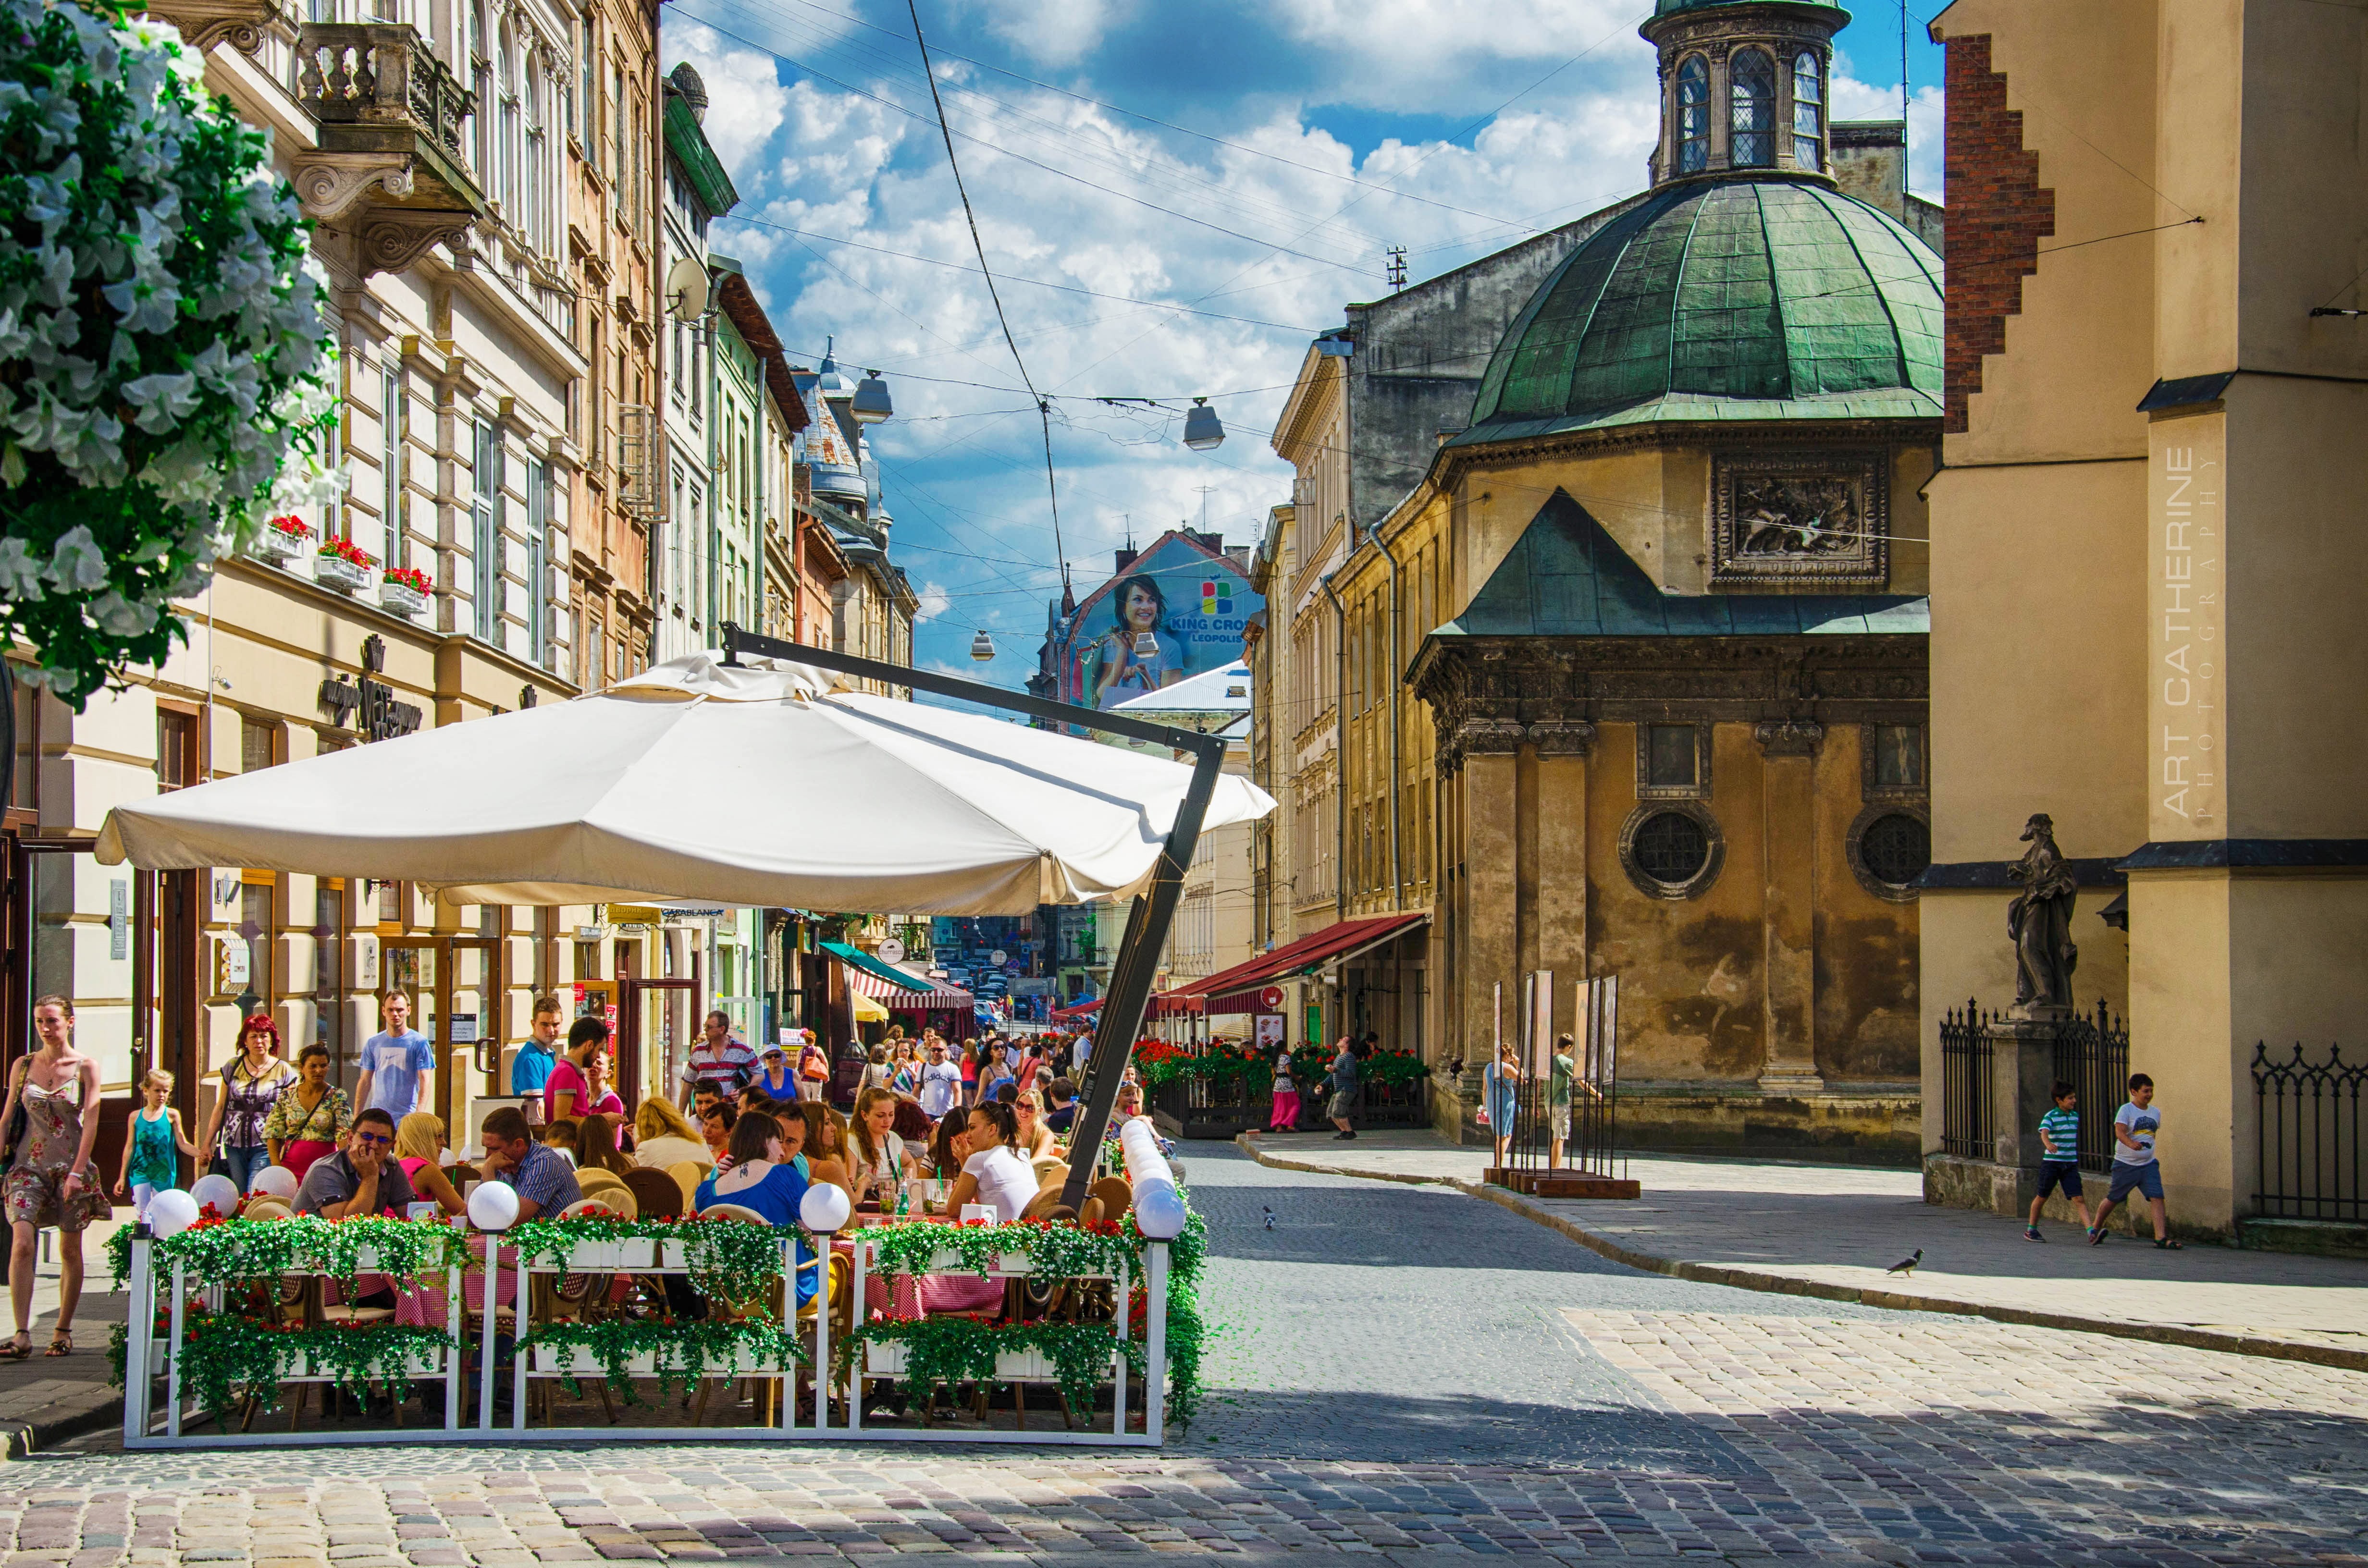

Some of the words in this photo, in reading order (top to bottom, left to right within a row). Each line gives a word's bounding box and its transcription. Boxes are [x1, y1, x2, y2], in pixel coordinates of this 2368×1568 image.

[1172, 618, 1208, 630] KING
[1213, 619, 1248, 630] CRO
[1192, 634, 1242, 643] LEOPOLIS
